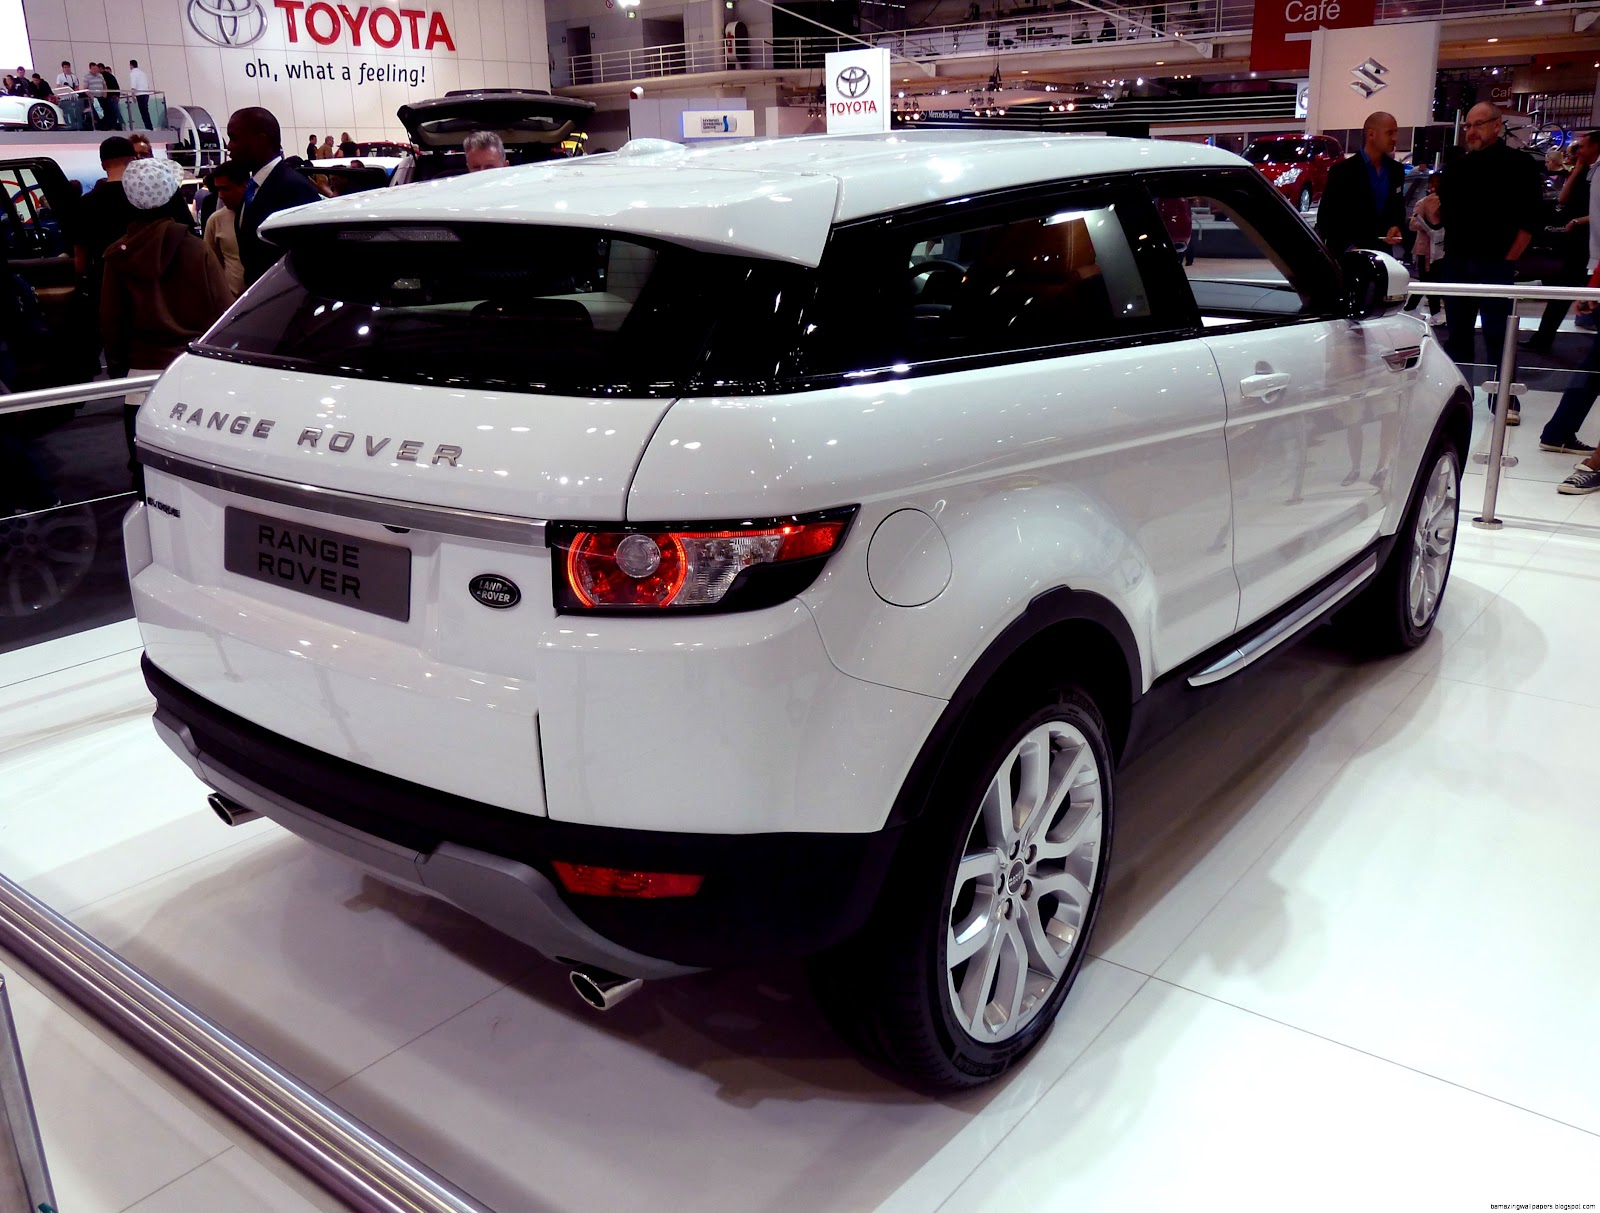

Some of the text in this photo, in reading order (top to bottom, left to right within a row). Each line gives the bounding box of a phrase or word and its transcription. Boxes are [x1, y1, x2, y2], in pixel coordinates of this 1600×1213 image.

[1285, 0, 1341, 22] Café
[274, 0, 456, 51] TOYOTA
[245, 58, 426, 87] oh, what a feeling!
[1491, 87, 1512, 98] Caf
[829, 100, 877, 115] TOYOTA
[928, 110, 960, 119] Mercedes-Benz
[169, 402, 464, 468] RANGE ROVER
[258, 524, 360, 569] RANGE
[258, 552, 361, 599] ROVER
[479, 580, 503, 591] LAND
[481, 590, 511, 603] ROVER
